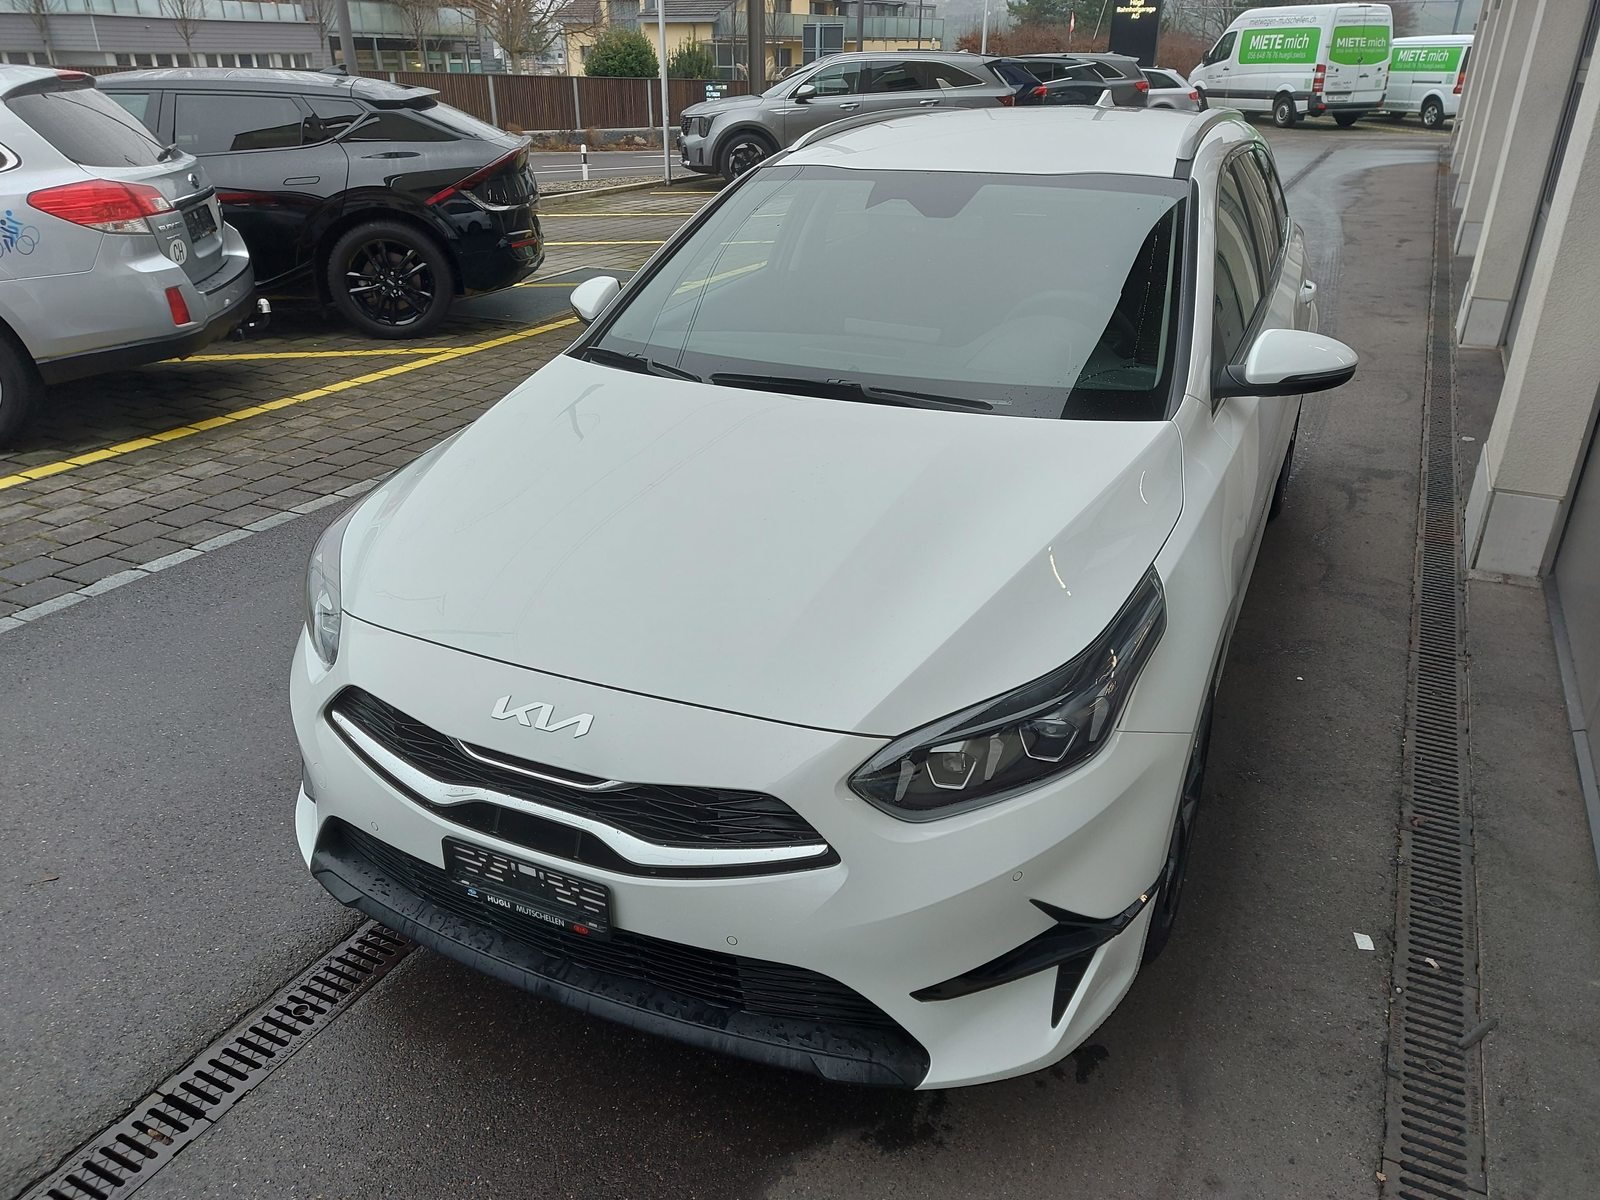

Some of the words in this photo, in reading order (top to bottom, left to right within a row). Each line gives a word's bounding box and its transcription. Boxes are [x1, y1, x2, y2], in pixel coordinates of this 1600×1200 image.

[1249, 34, 1284, 50] MIETE
[1284, 33, 1310, 49] mich
[1336, 37, 1367, 47] MIETE
[1367, 37, 1386, 47] mich
[1398, 49, 1428, 62] MIETE
[1427, 49, 1449, 61] mich
[173, 243, 185, 262] CH
[491, 695, 594, 738] KIA
[515, 904, 565, 927] MUTSCHELLEN
